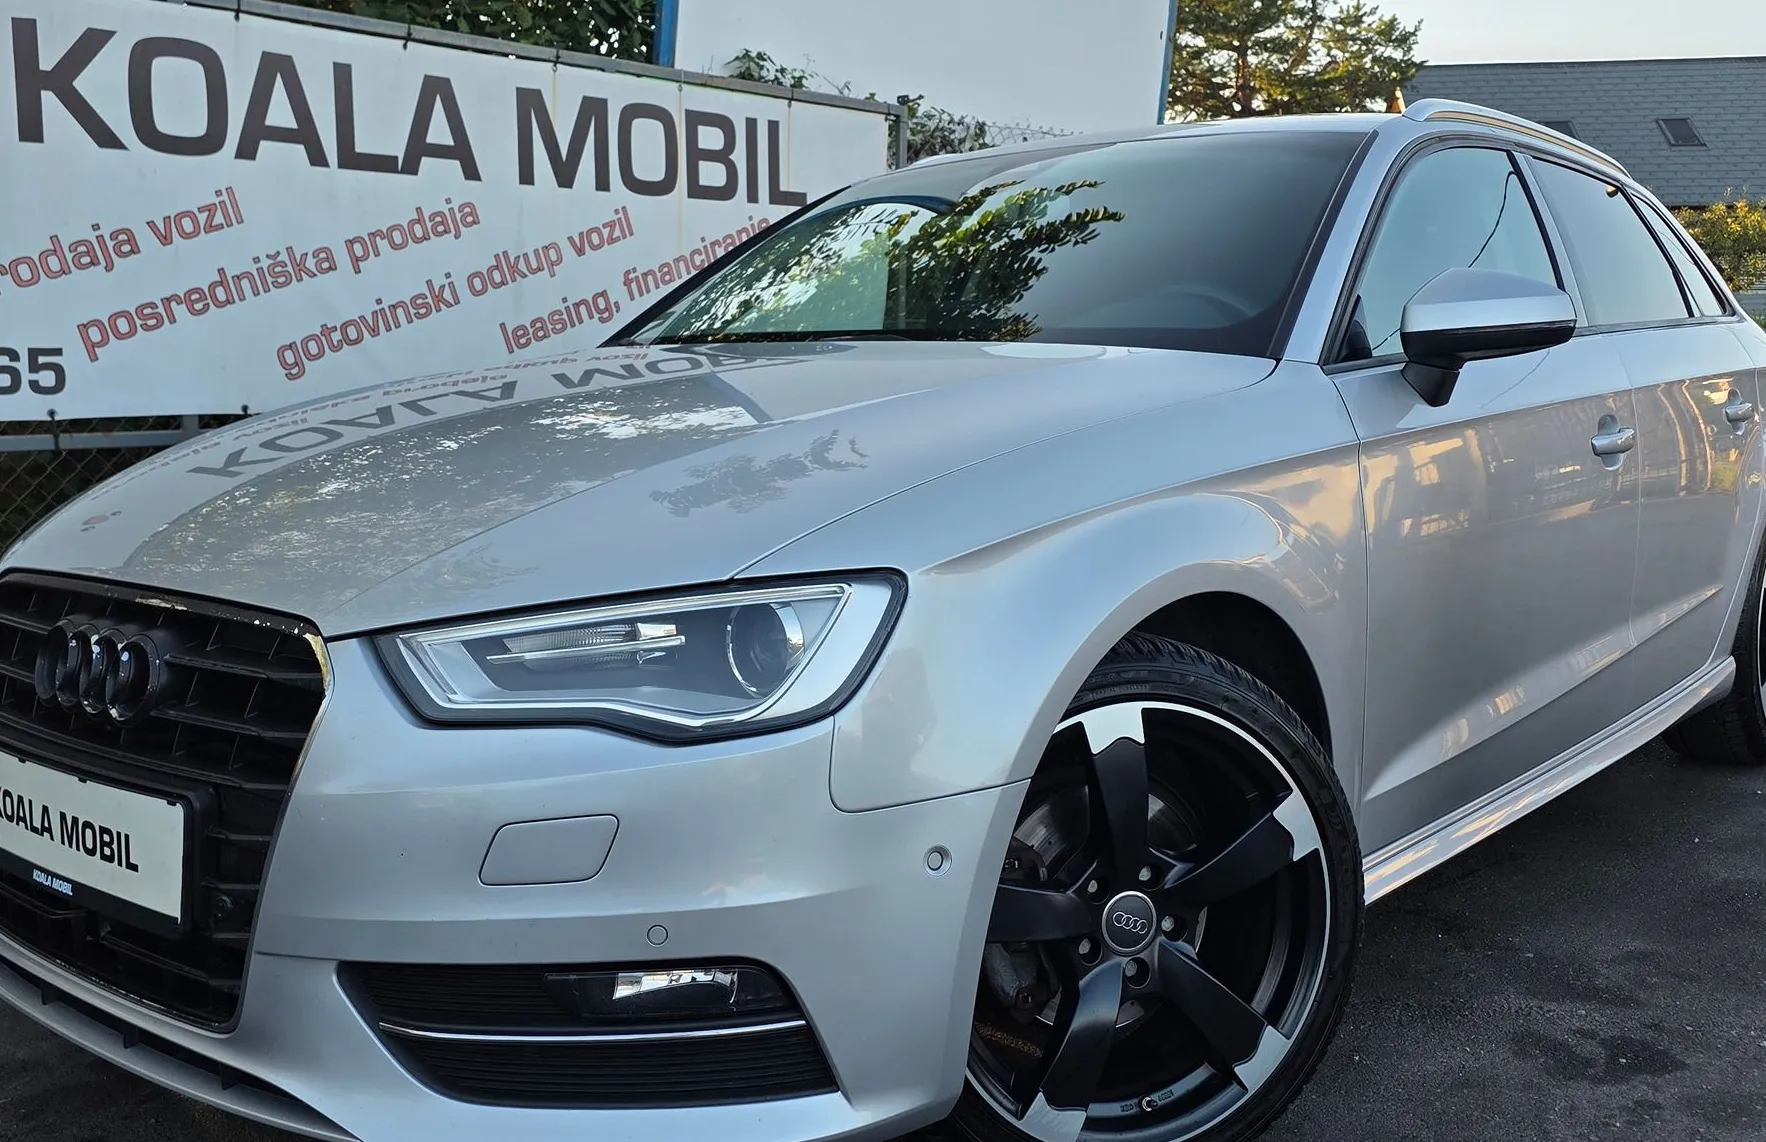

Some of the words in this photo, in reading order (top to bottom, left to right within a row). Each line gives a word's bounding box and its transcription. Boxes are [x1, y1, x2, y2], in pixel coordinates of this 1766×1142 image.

[11, 17, 482, 182] KOALA
[516, 86, 807, 206] MOBIL
[146, 186, 244, 247] vozil
[77, 245, 337, 363] posredniška
[344, 197, 480, 274] prodaja
[276, 272, 460, 381] gotovinski
[467, 240, 563, 297] odkup
[568, 206, 634, 258] vozil
[499, 289, 621, 354] leasing,
[0, 785, 55, 842] OALA
[59, 810, 139, 873] MOBIL
[33, 868, 52, 887] KOALA
[52, 878, 73, 896] MOBIL
